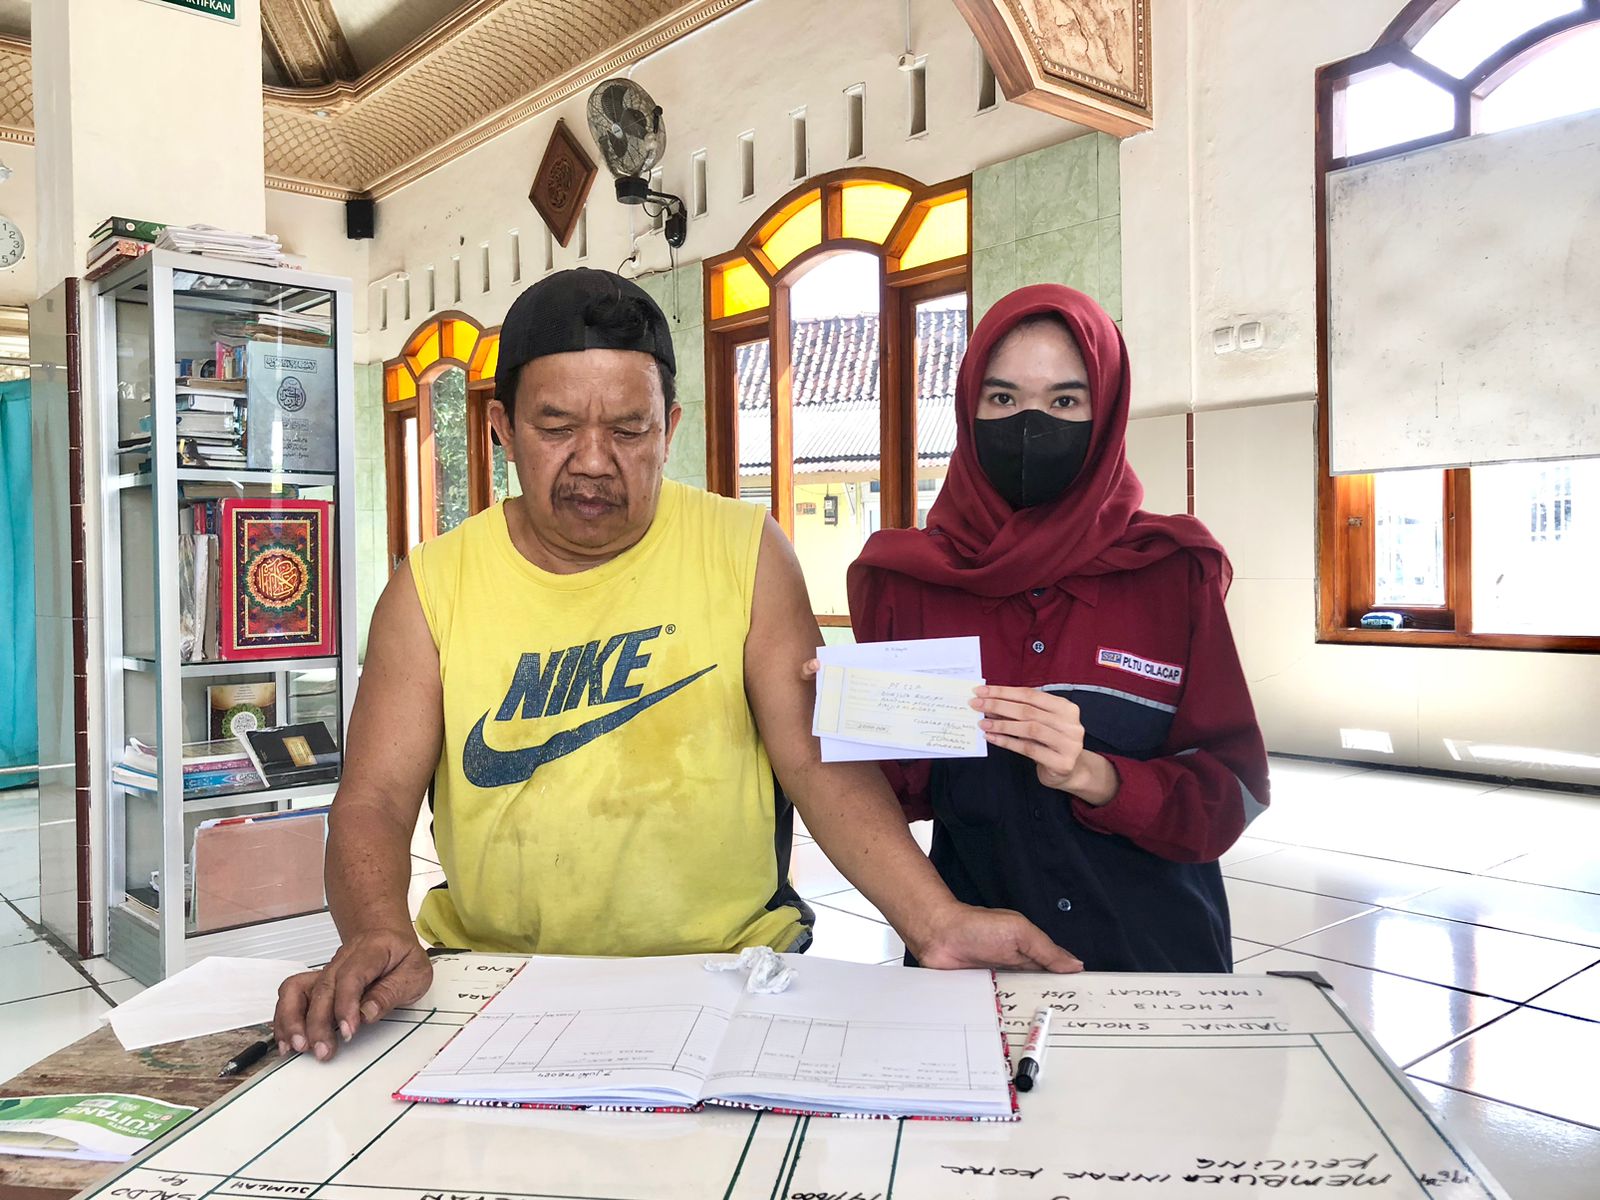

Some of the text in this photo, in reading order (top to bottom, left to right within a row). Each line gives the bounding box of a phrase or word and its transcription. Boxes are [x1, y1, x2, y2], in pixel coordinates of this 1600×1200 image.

[2, 223, 7, 231] 1
[9, 231, 16, 239] 2
[13, 240, 20, 248] 3
[1, 255, 8, 263] 5
[9, 249, 16, 257] 4
[494, 625, 663, 721] NIKE
[1122, 657, 1142, 671] PLTU
[1144, 663, 1180, 681] CILACAP
[1132, 1003, 1233, 1012] KHOTIB
[1060, 1020, 1289, 1032] JADWAL SHOLAT
[56, 1106, 163, 1132] KUITANSI
[940, 1165, 1043, 1179] KOTAK
[1182, 1172, 1392, 1188] MEMBUKA
[230, 1182, 311, 1194] JUMLAH
